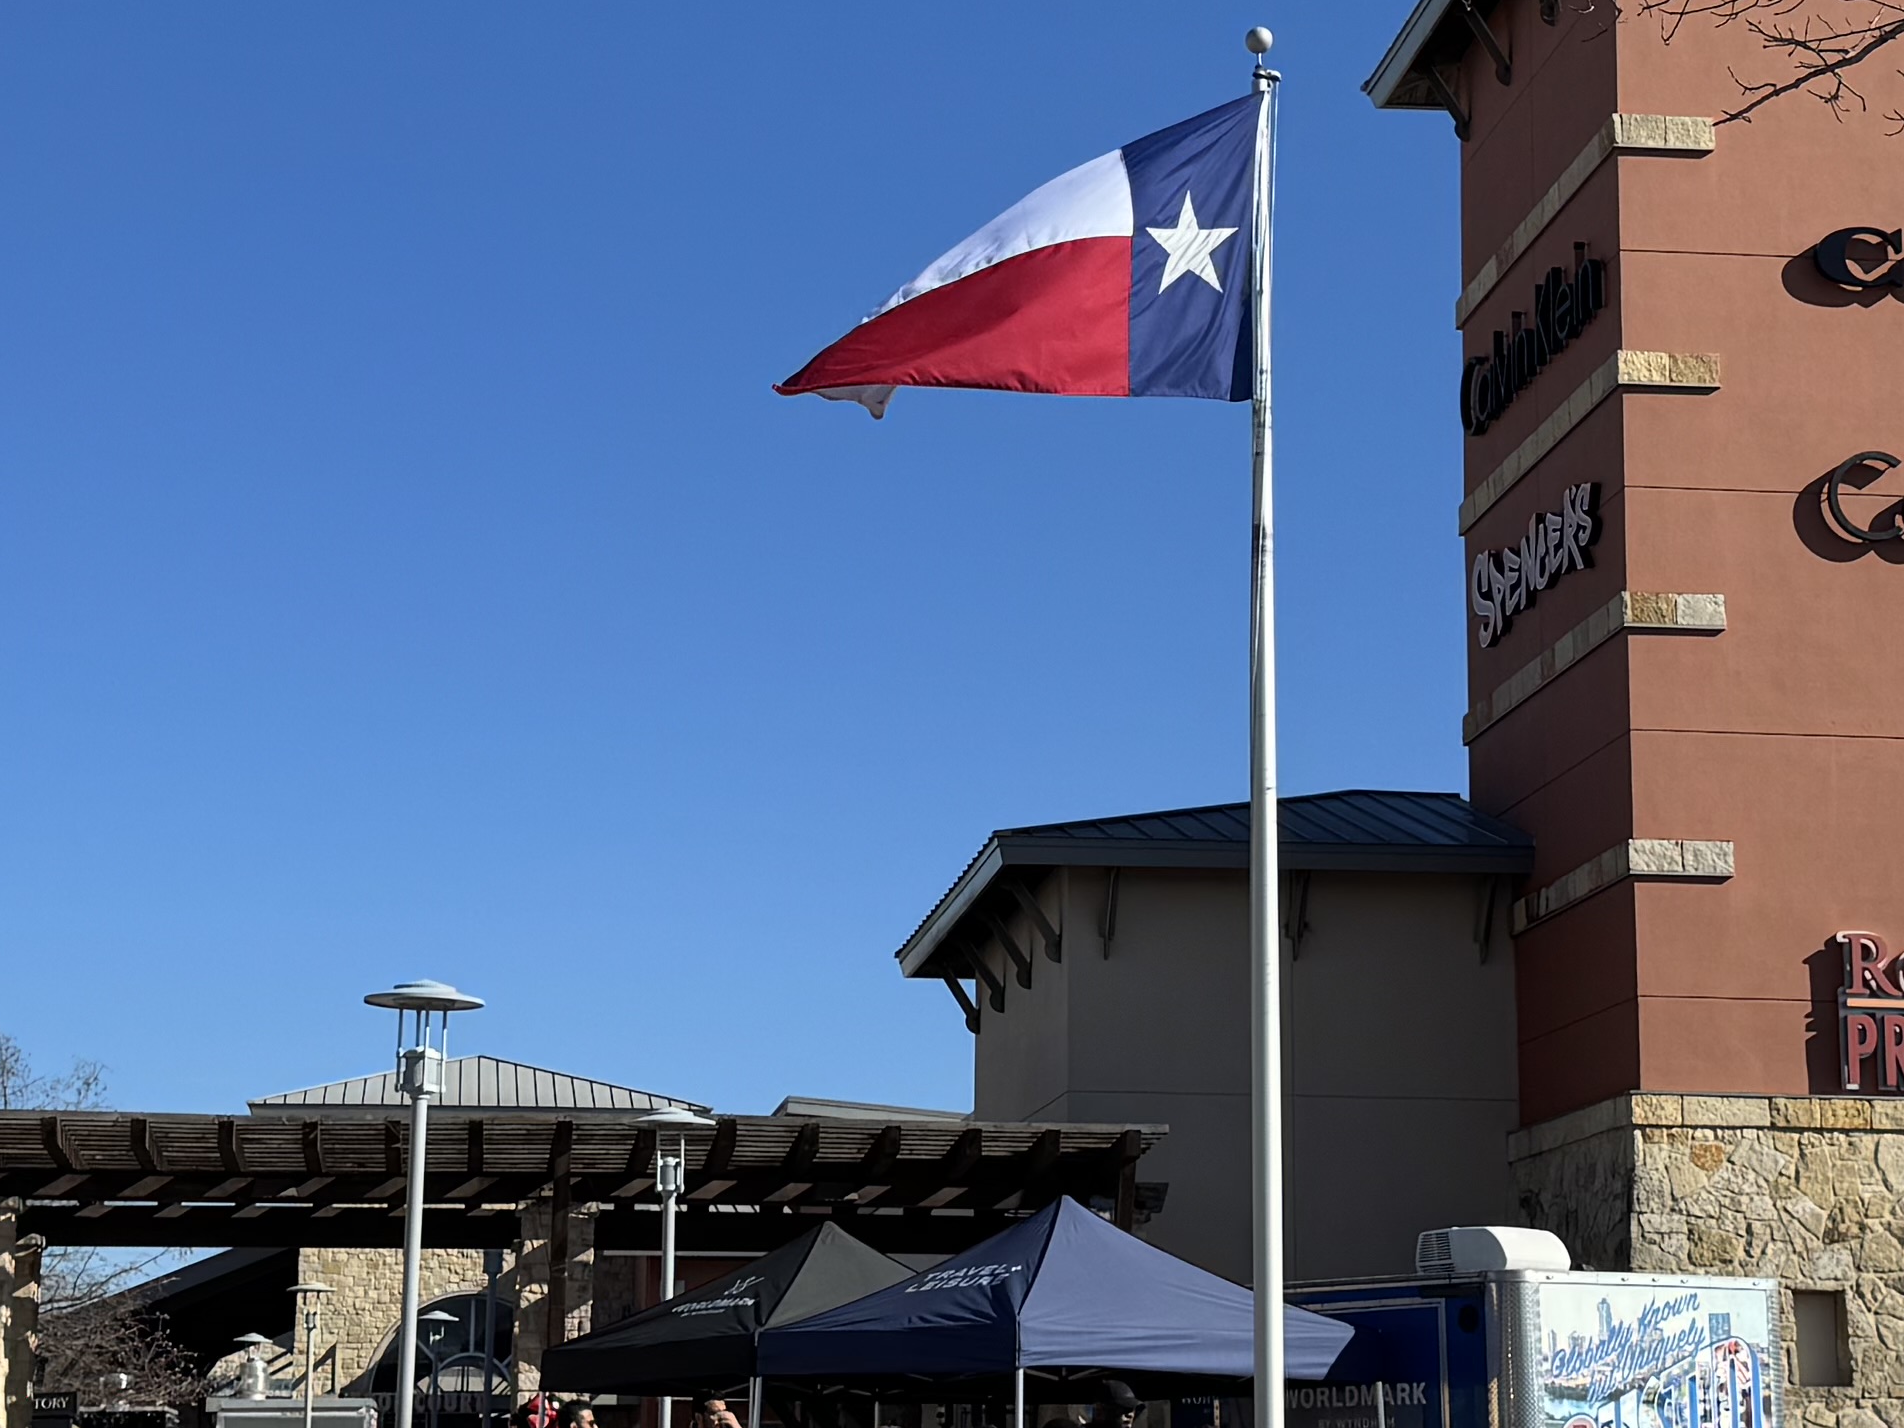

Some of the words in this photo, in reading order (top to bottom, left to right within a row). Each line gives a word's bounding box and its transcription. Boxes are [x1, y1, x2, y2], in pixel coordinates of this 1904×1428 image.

[1461, 312, 1537, 436] Calvin
[1534, 242, 1605, 368] Klein
[1472, 482, 1593, 649] SPENCER'S
[904, 1273, 1010, 1293] LEISURE
[1552, 1320, 1634, 1379] Globally
[1637, 1292, 1700, 1336] Known
[1587, 1354, 1622, 1408] but
[1617, 1317, 1706, 1383] Uniquely
[1337, 1417, 1395, 1428] WYNDHM
